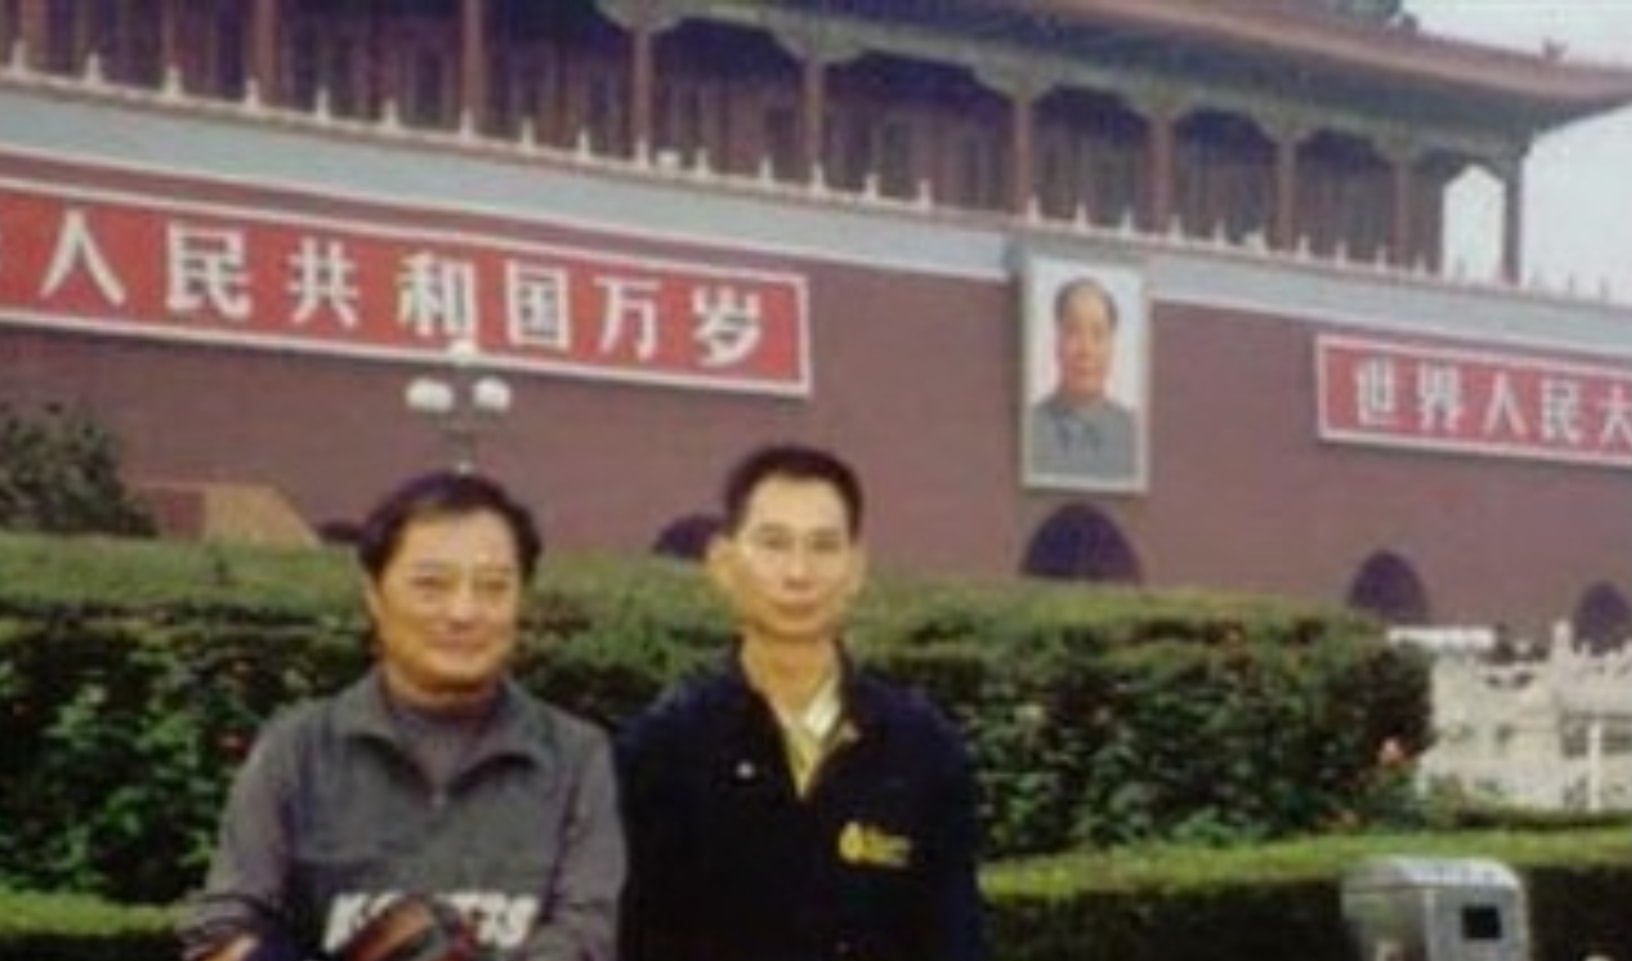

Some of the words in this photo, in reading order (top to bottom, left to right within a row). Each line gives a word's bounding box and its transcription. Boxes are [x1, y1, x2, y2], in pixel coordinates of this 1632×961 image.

[38, 207, 764, 368] 人民共和国万岁
[1355, 355, 1632, 446] 世界人民大
